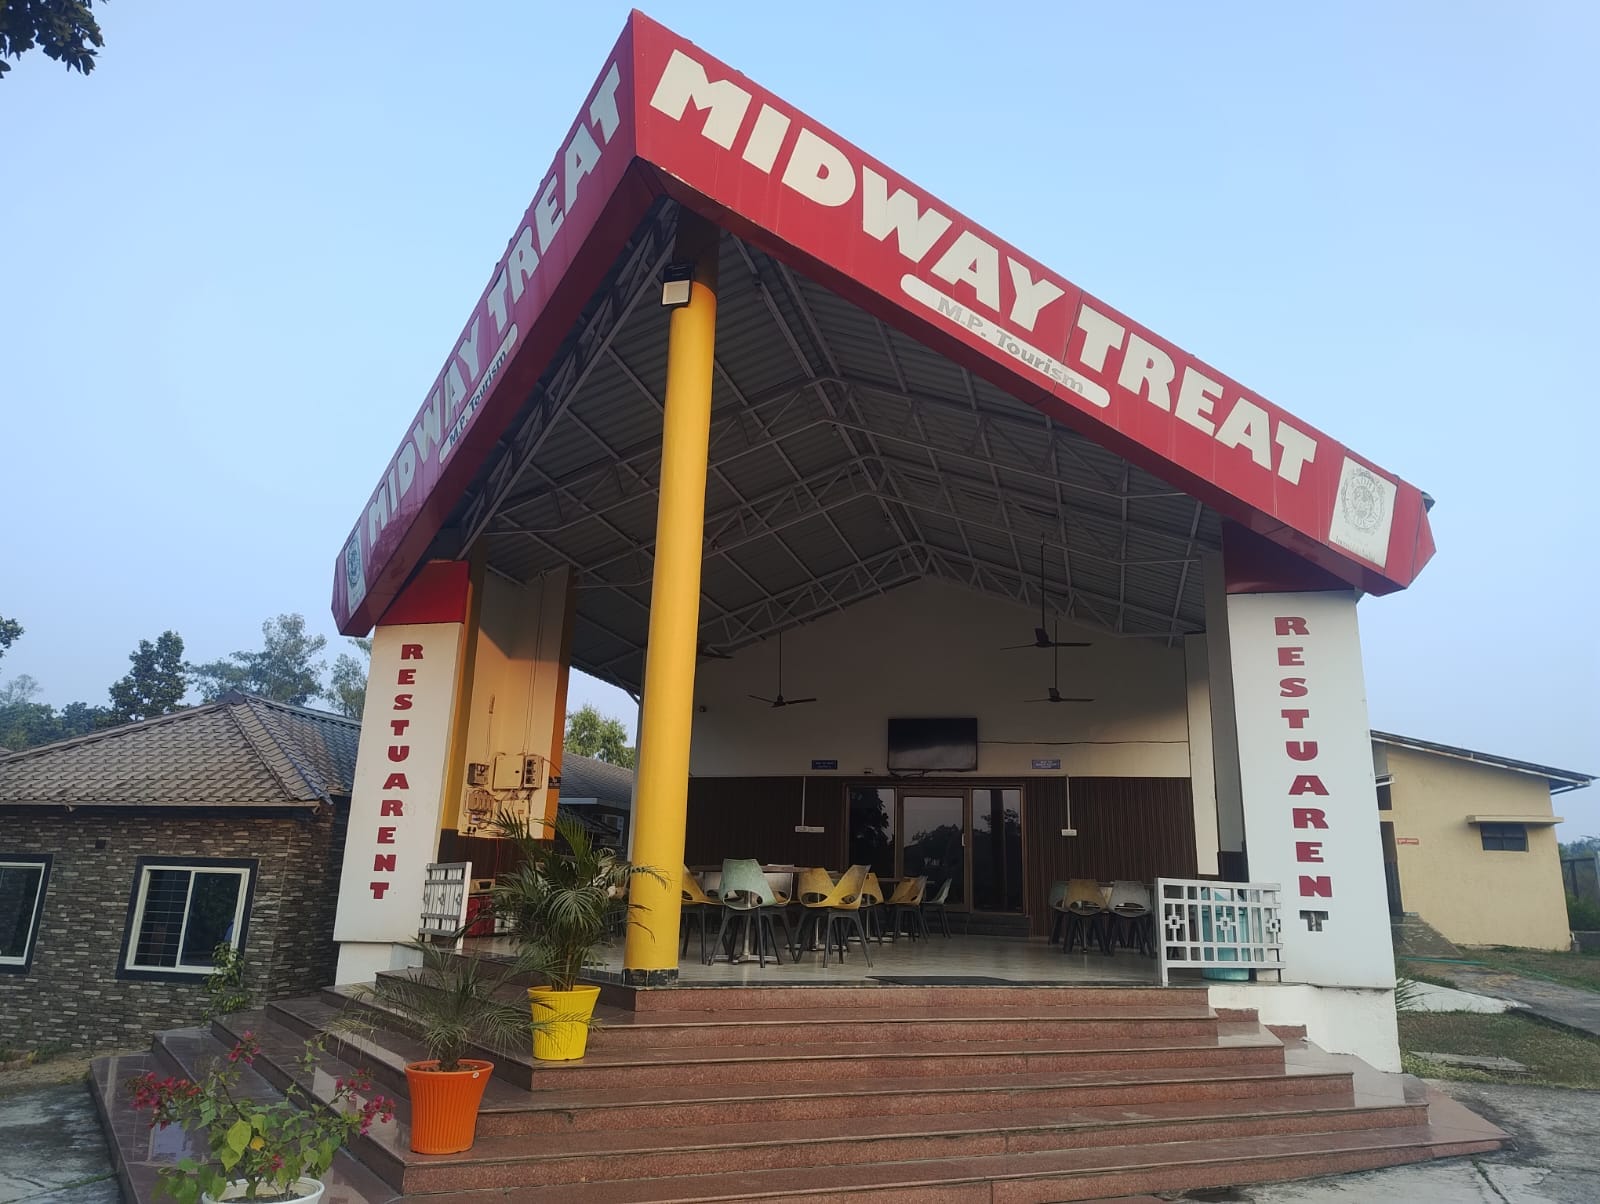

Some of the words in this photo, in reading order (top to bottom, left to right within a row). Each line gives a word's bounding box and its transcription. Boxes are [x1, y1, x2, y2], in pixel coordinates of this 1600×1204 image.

[369, 315, 480, 547] MIDWAY
[487, 61, 622, 336] TREAT
[449, 415, 468, 447] M.P.
[469, 350, 507, 412] Tourism
[649, 49, 1066, 332] MIDWAY
[1077, 303, 1318, 486] TREAT
[937, 296, 988, 338] M.P.
[997, 328, 1084, 394] Tourism
[370, 643, 424, 900] RESTUARENT
[1274, 616, 1333, 932] RESTUARENT
